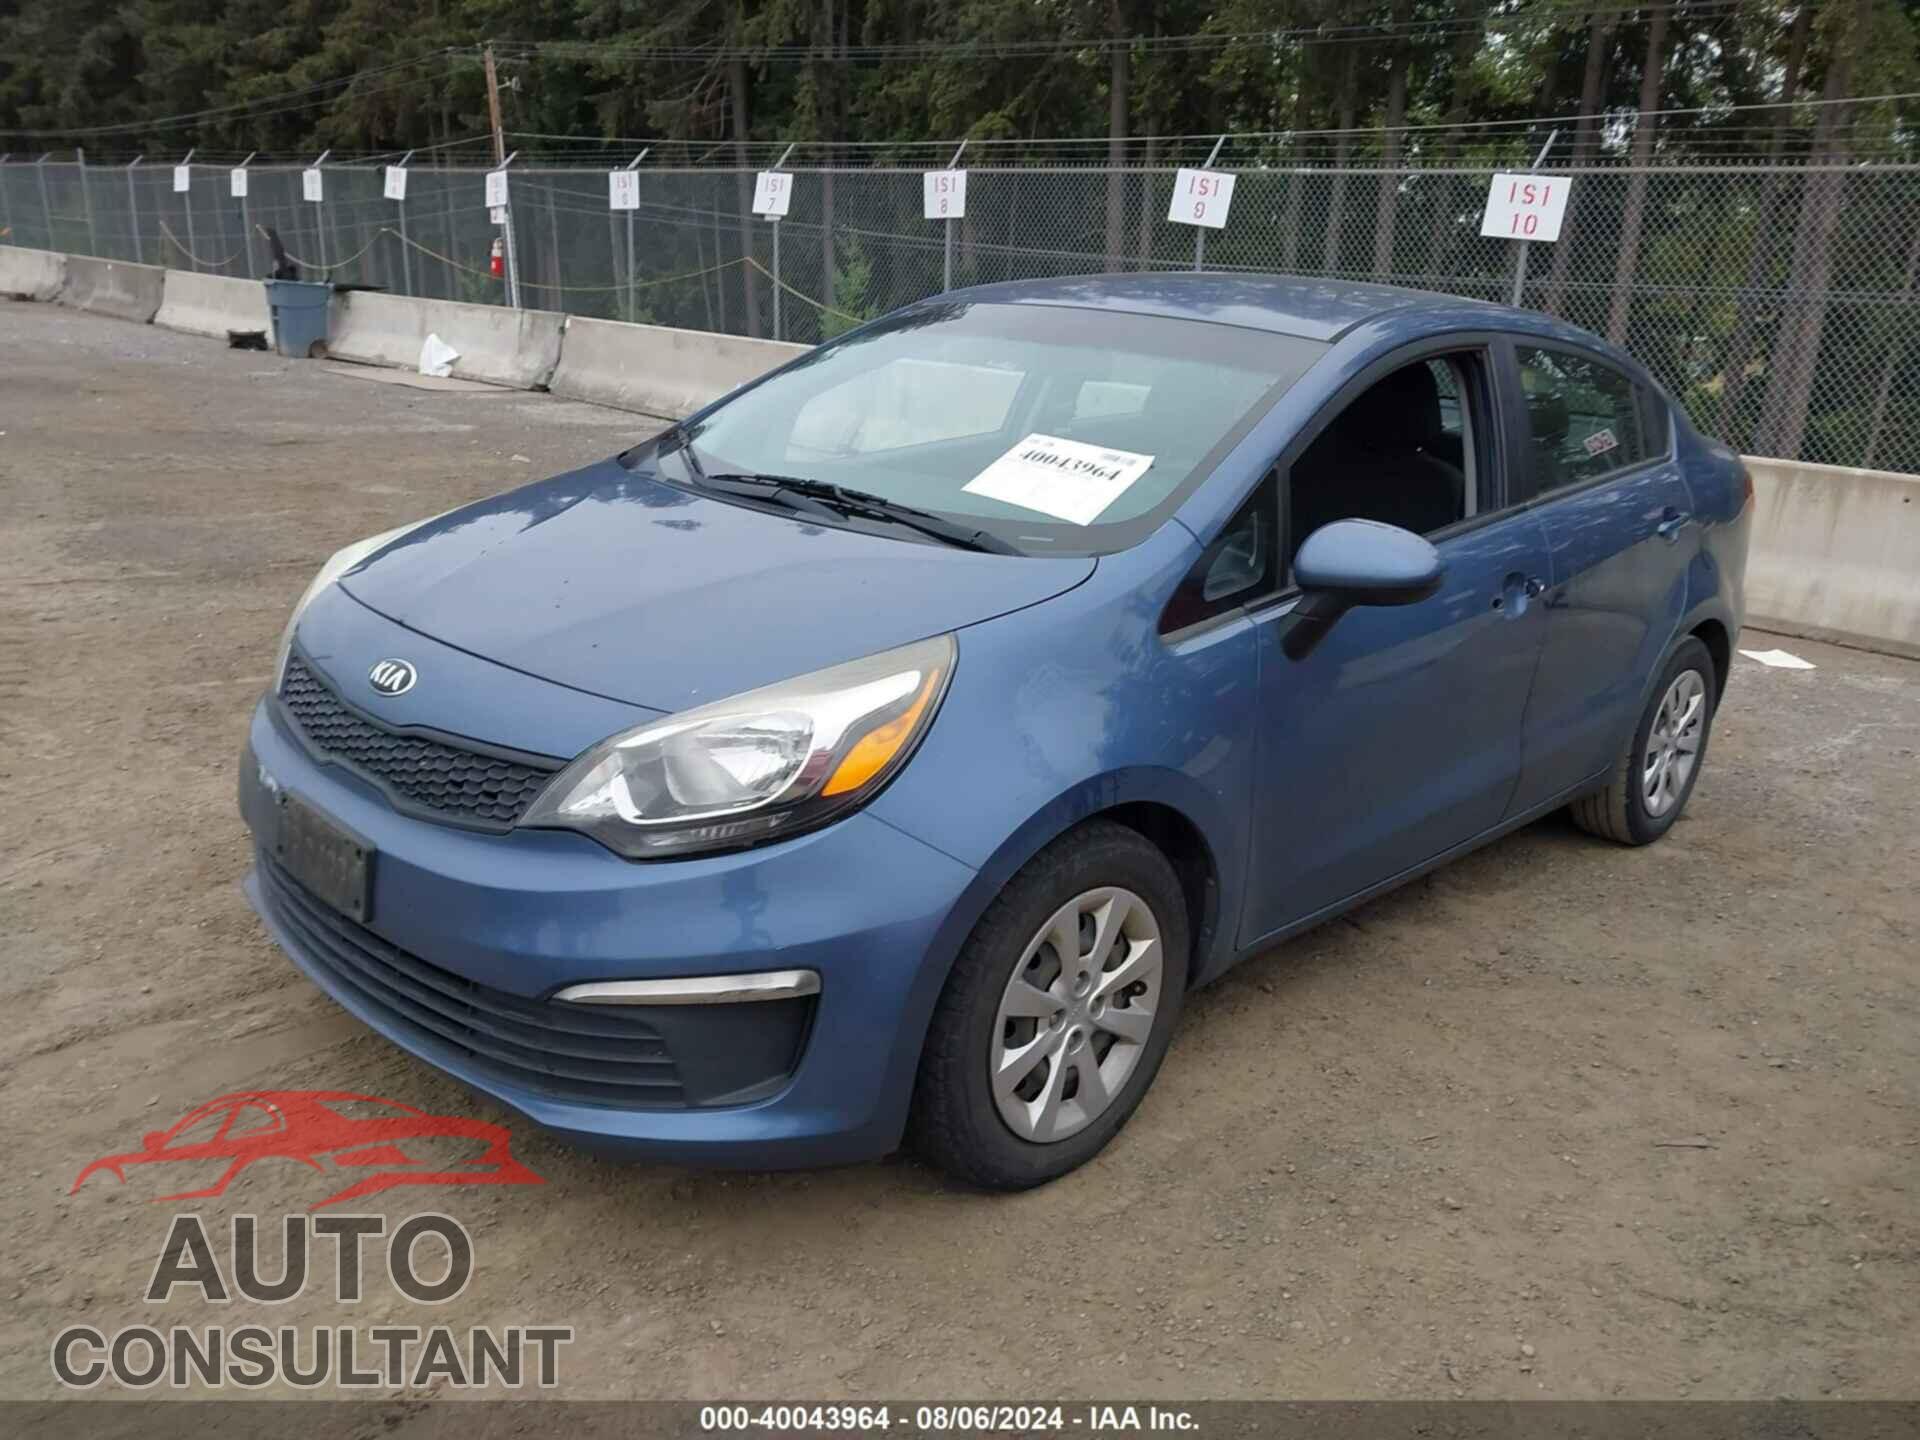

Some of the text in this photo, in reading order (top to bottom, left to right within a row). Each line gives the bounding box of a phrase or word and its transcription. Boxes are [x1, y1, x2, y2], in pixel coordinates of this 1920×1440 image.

[767, 197, 776, 210] 7
[940, 198, 948, 214] 8
[1511, 213, 1537, 235] 10
[1020, 449, 1122, 481] 40043964
[370, 661, 407, 691] KIA
